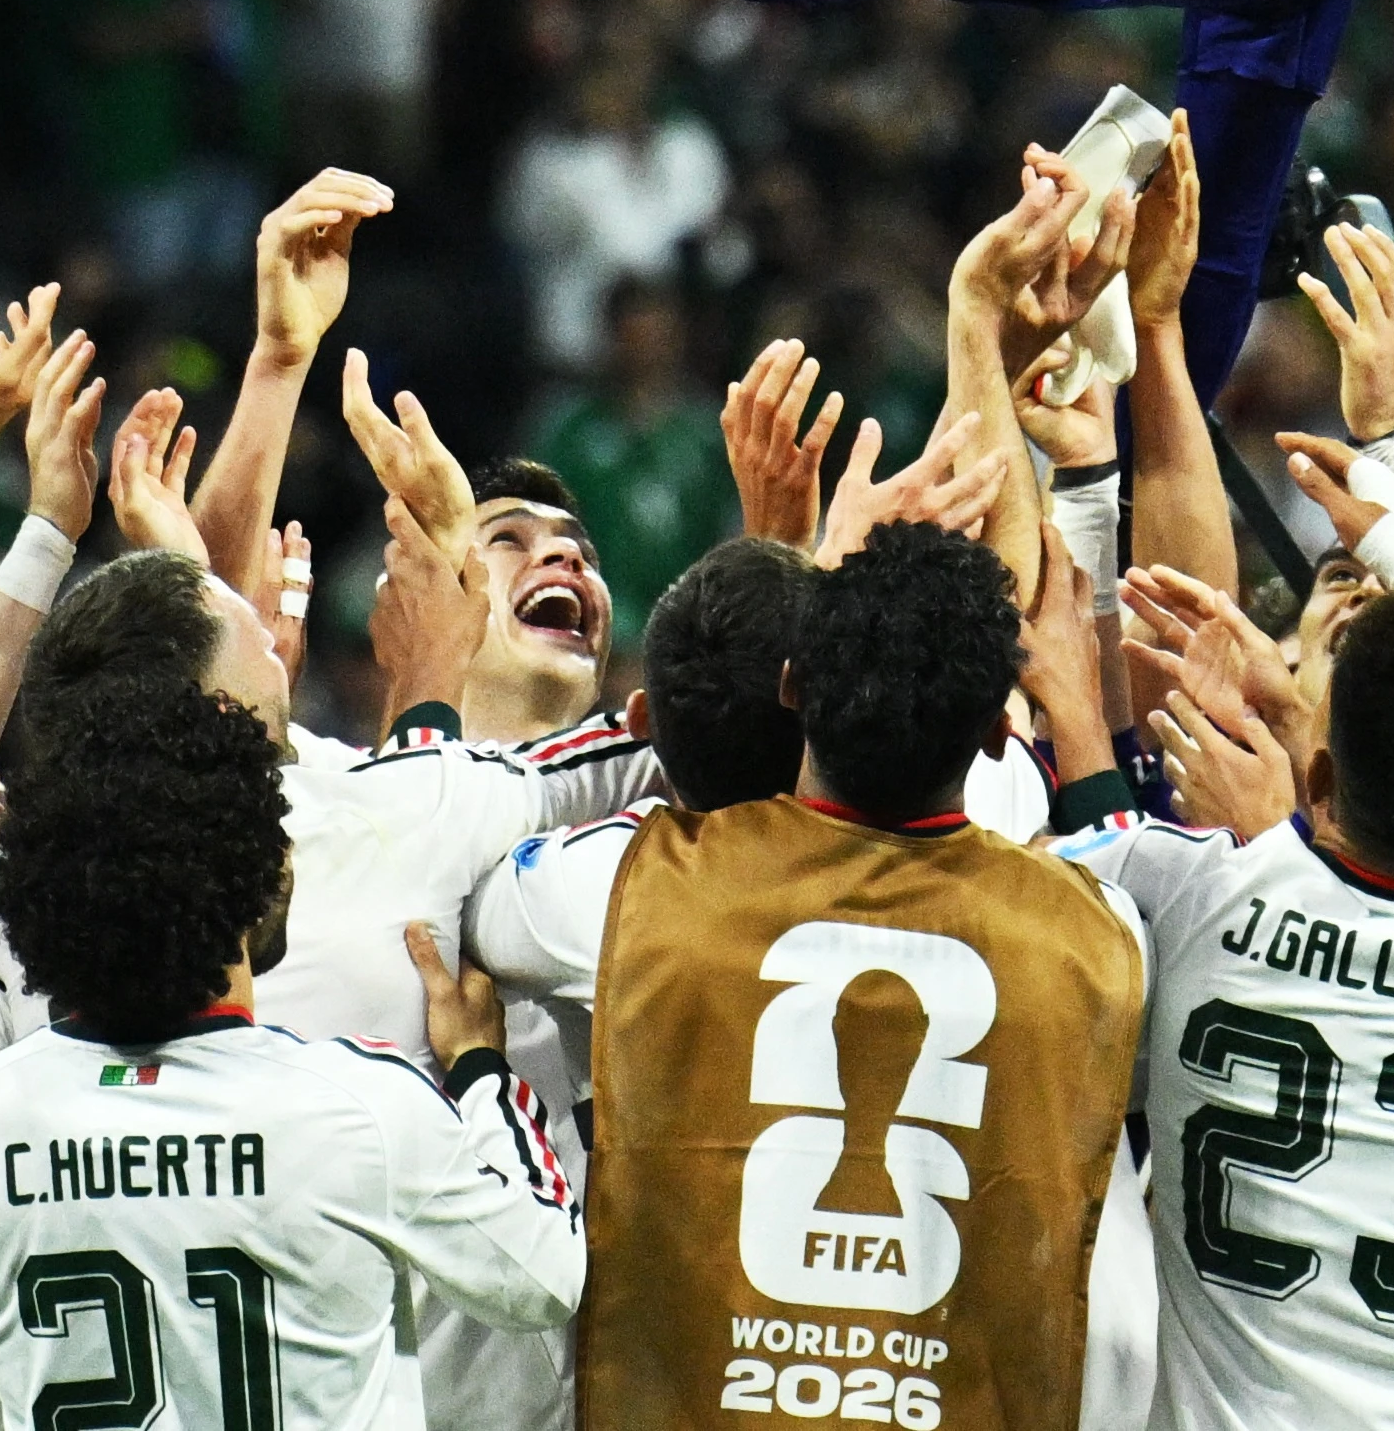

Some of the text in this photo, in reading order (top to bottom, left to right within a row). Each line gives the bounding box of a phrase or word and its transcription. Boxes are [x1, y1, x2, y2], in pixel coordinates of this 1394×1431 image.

[4, 1132, 265, 1207] C.HUERTA
[803, 1231, 908, 1277] FIFA
[17, 1247, 283, 1431] 21
[731, 1316, 949, 1370] WORLD CUP
[720, 1357, 942, 1431] 2026
